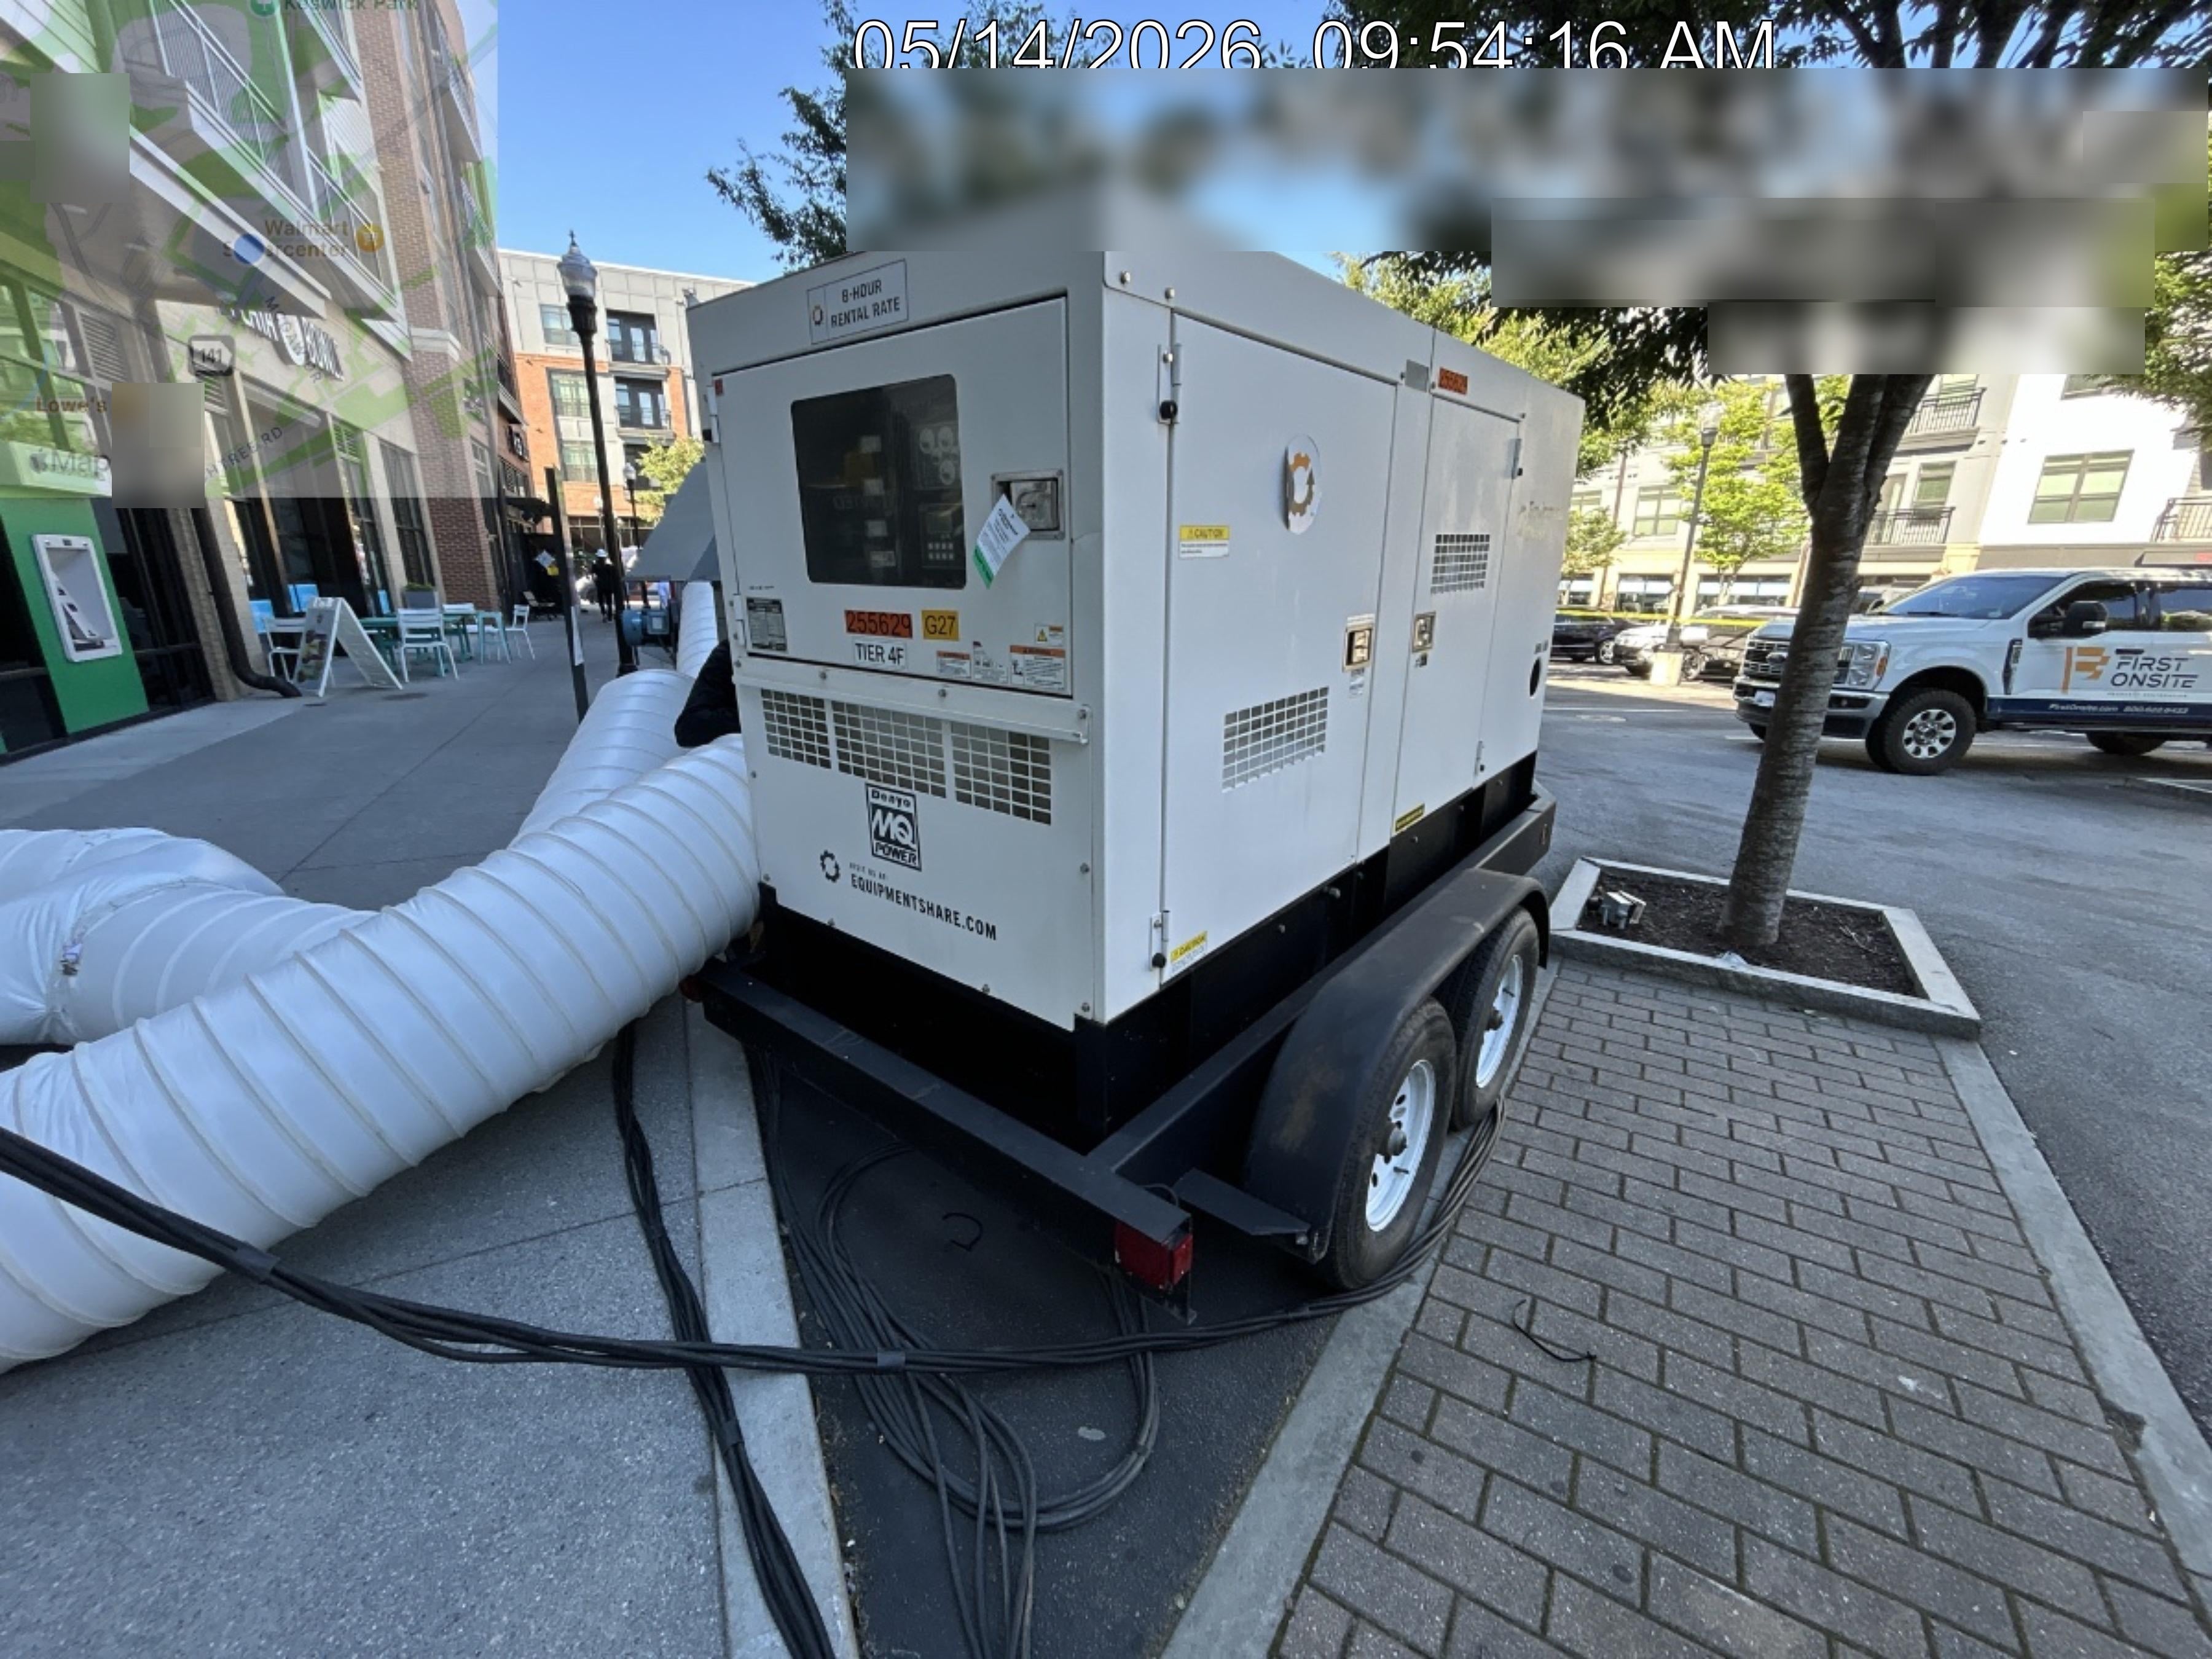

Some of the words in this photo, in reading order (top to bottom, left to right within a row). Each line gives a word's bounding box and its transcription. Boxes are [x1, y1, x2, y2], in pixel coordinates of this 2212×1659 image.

[841, 278, 882, 303] 8-HOUR
[831, 306, 869, 328] RENTAL
[871, 296, 900, 318] RATE
[845, 610, 912, 638] 255629
[924, 614, 956, 636] G27
[855, 643, 885, 664] TIER
[888, 646, 904, 666] 4F
[2116, 655, 2192, 672] FIRST
[2110, 673, 2199, 689] ONSITE
[872, 789, 911, 808] Denyo
[873, 809, 916, 849] MQ
[875, 841, 917, 865] POWER
[850, 873, 997, 941] EQUIPMENTSHARE.COM
